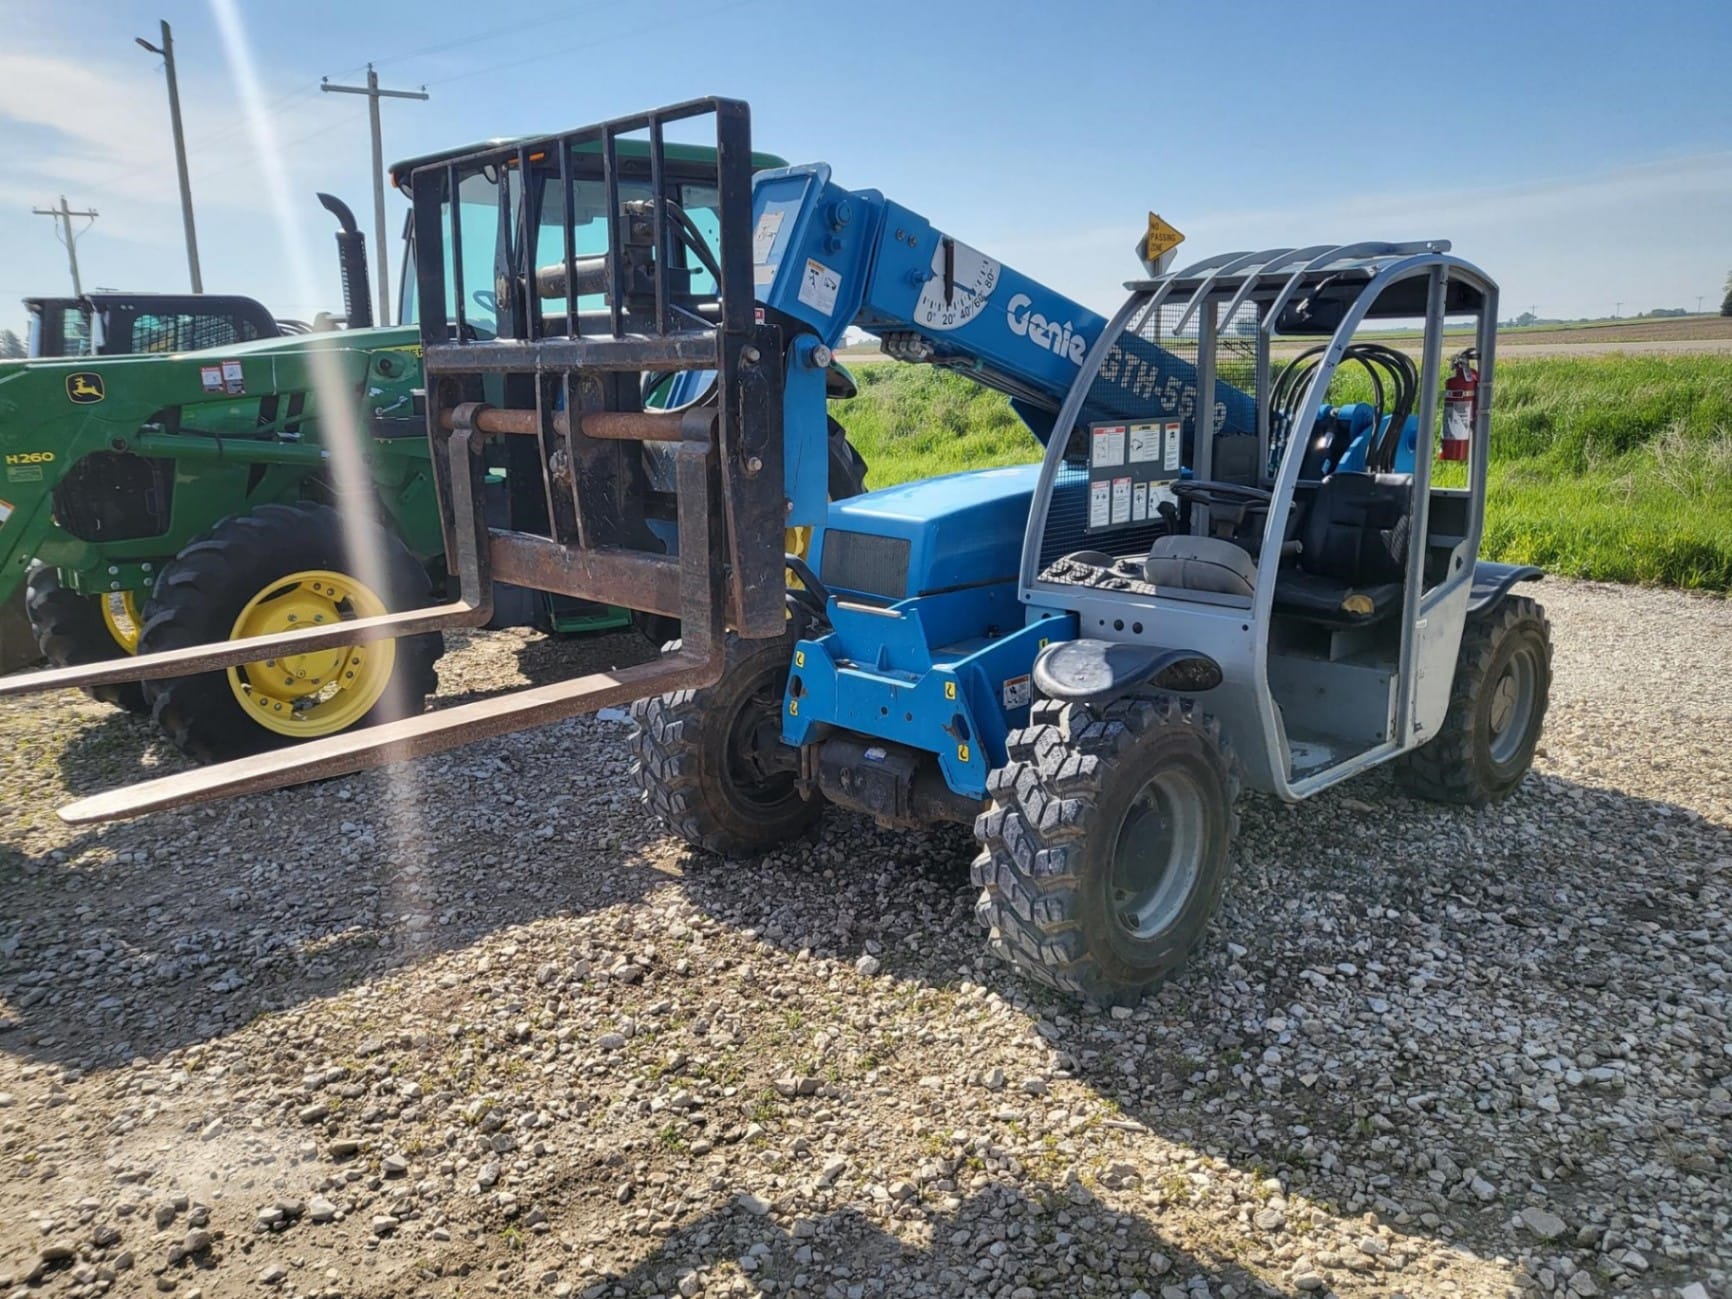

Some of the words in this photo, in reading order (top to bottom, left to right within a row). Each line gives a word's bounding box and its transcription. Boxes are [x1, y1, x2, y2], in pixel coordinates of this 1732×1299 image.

[1150, 233, 1177, 242] PASSING
[1007, 293, 1087, 367] Genie
[1099, 343, 1228, 434] GTH-559
